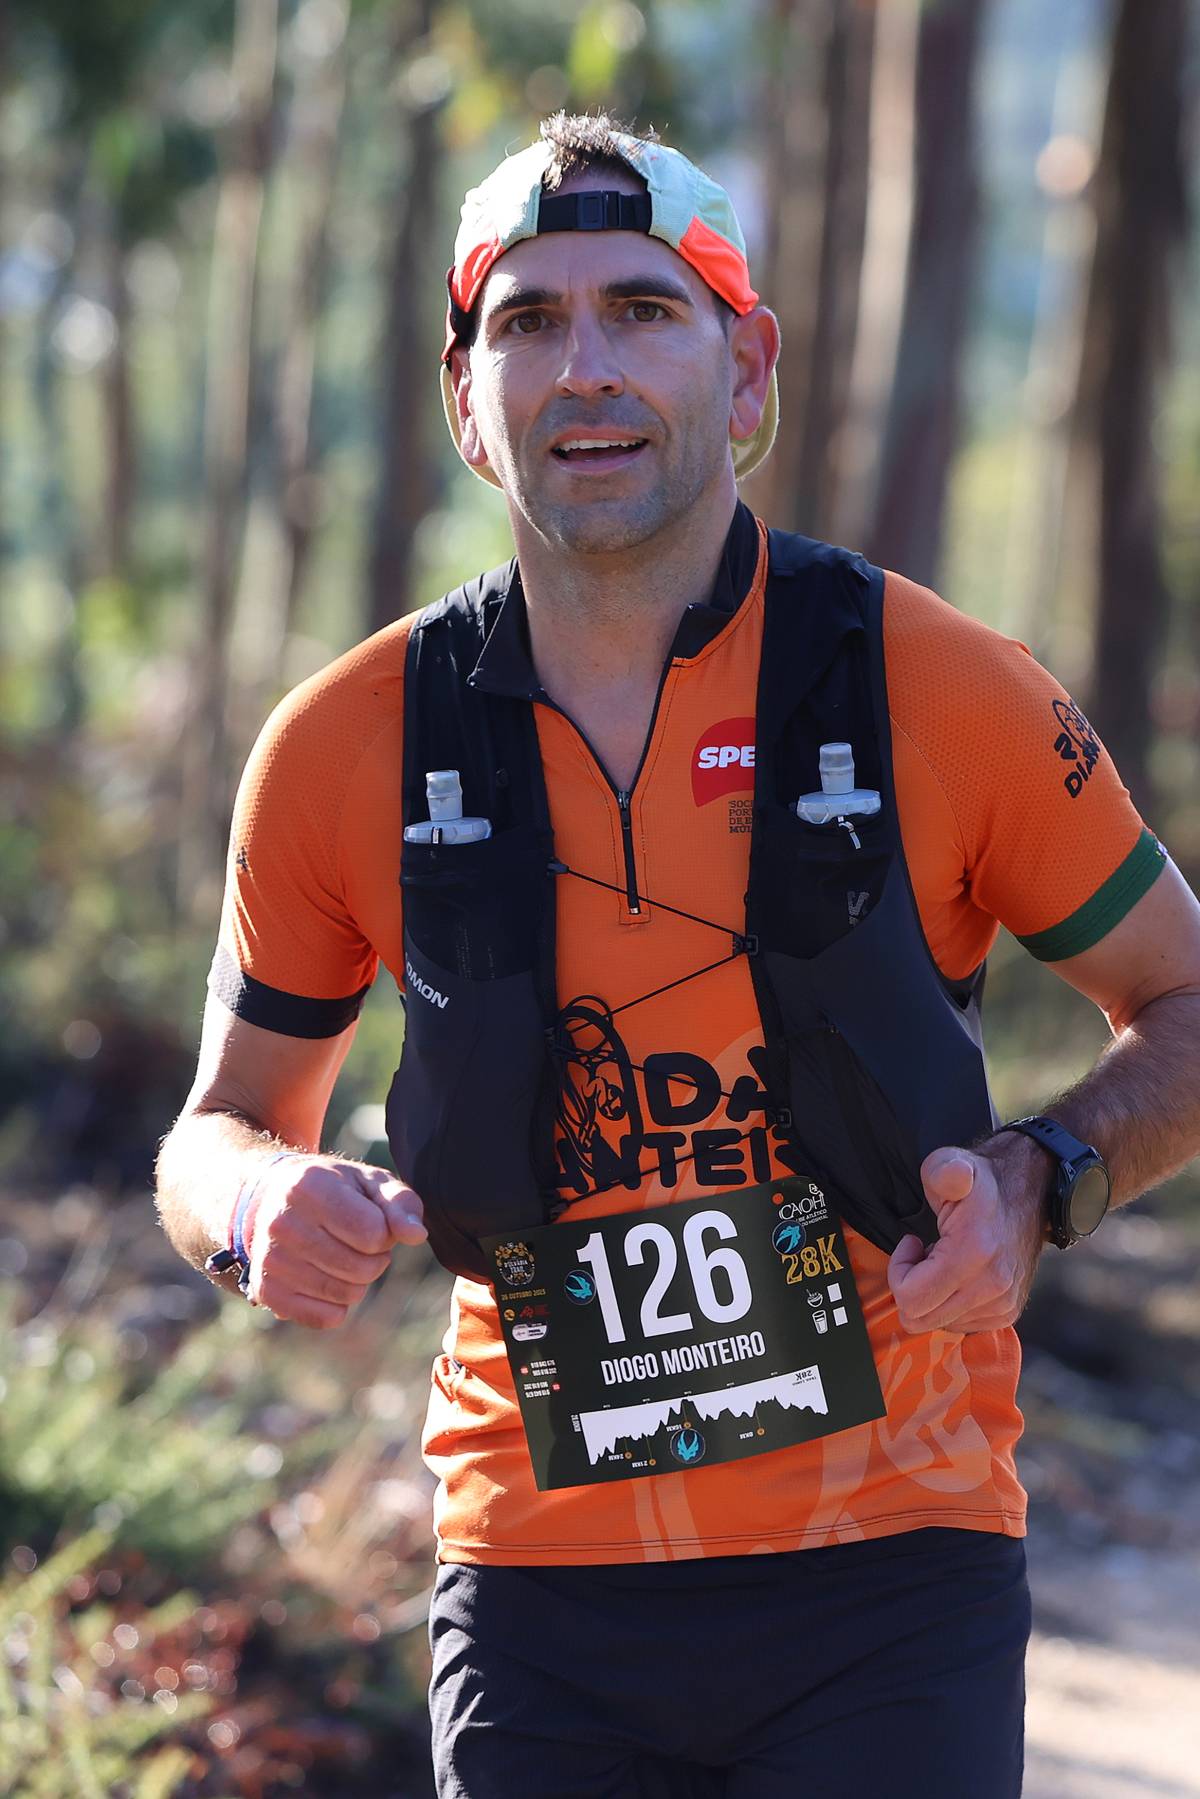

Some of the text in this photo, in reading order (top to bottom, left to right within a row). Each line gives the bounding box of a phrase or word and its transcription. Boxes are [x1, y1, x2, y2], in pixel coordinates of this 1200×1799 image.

[698, 745, 756, 769] SPE
[405, 953, 450, 1009] OMON
[576, 1210, 753, 1344] 126
[781, 1233, 844, 1285] 28K
[600, 1331, 767, 1386] DIOGO MONTEIRO
